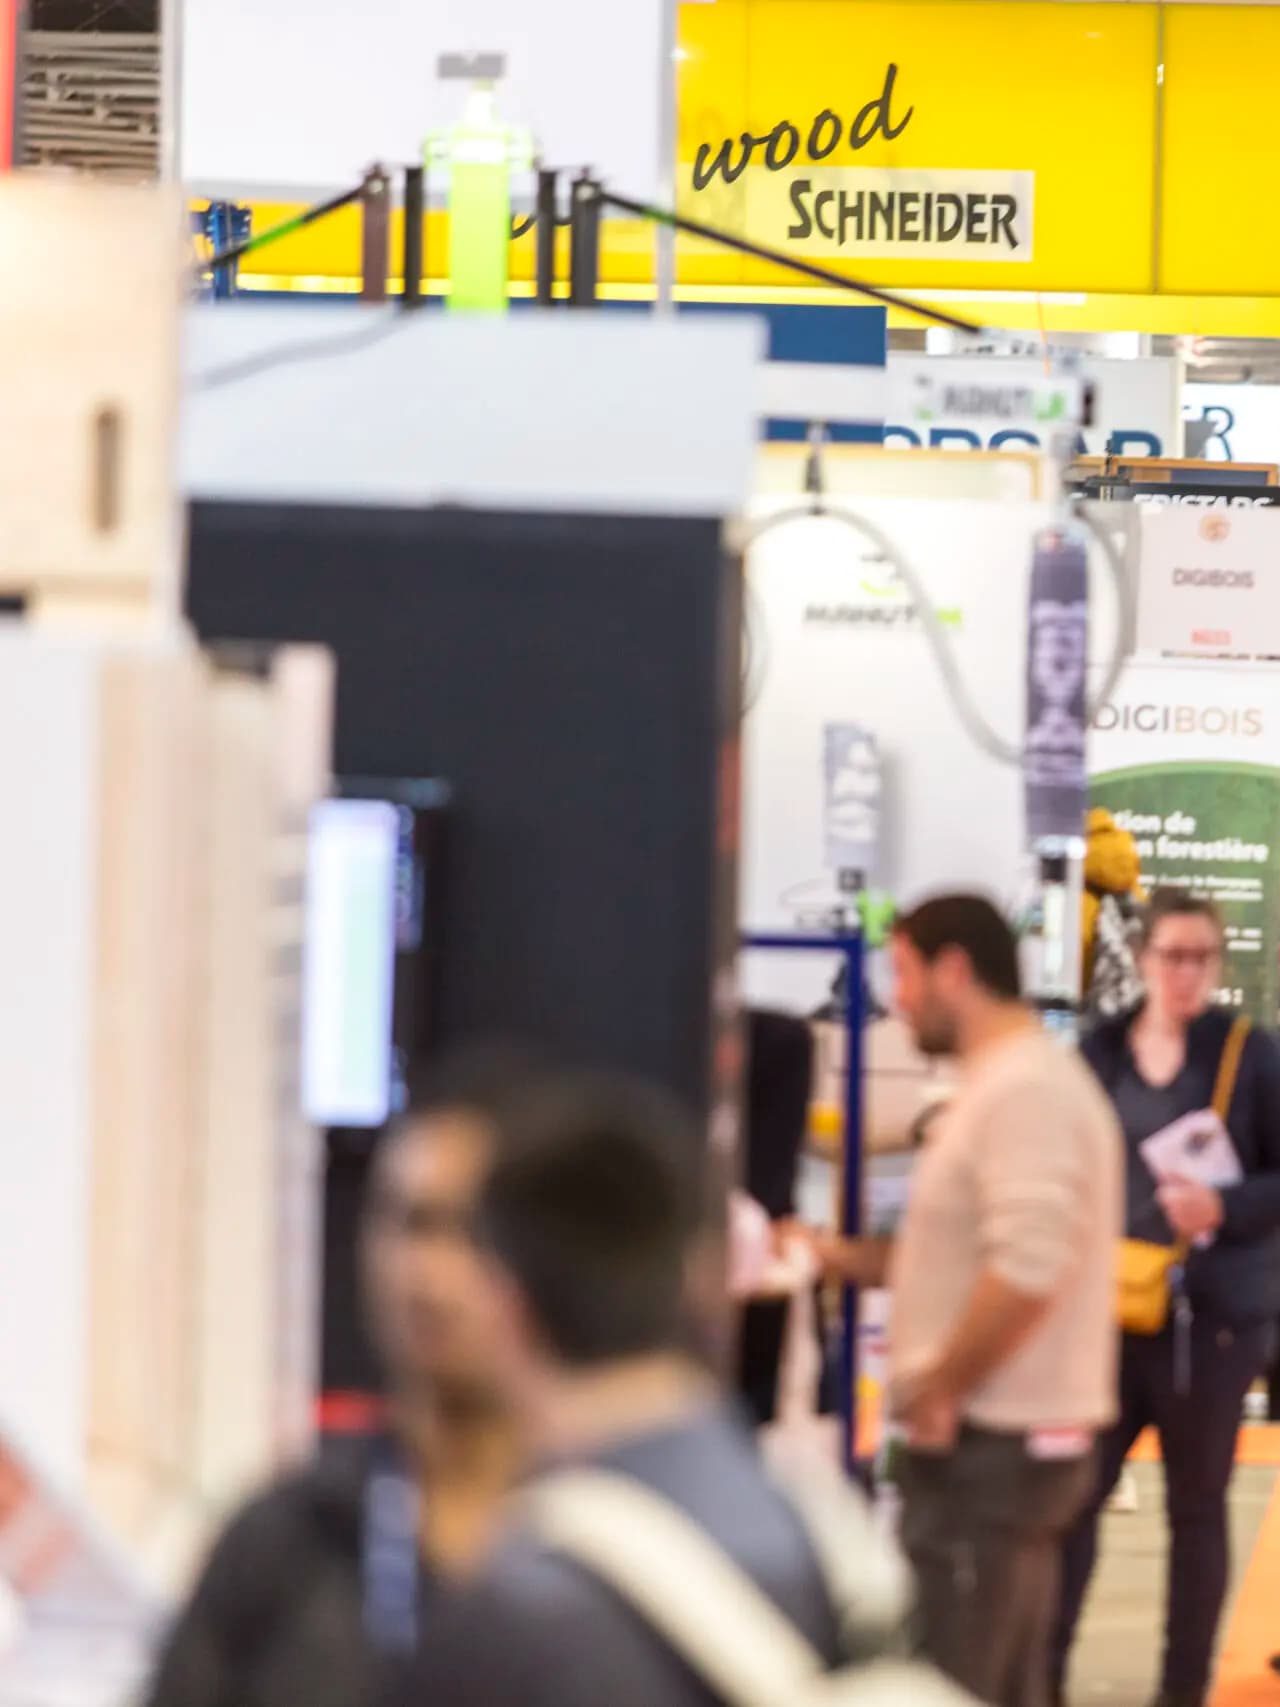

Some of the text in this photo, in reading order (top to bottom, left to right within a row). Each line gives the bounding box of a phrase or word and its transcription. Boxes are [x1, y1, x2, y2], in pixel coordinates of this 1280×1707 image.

[692, 63, 914, 191] wood
[787, 179, 1019, 249] SCHNEIDER
[1172, 568, 1254, 588] DIGIBOIS
[1091, 703, 1263, 737] DIGIBOIS
[1112, 809, 1196, 836] tion de
